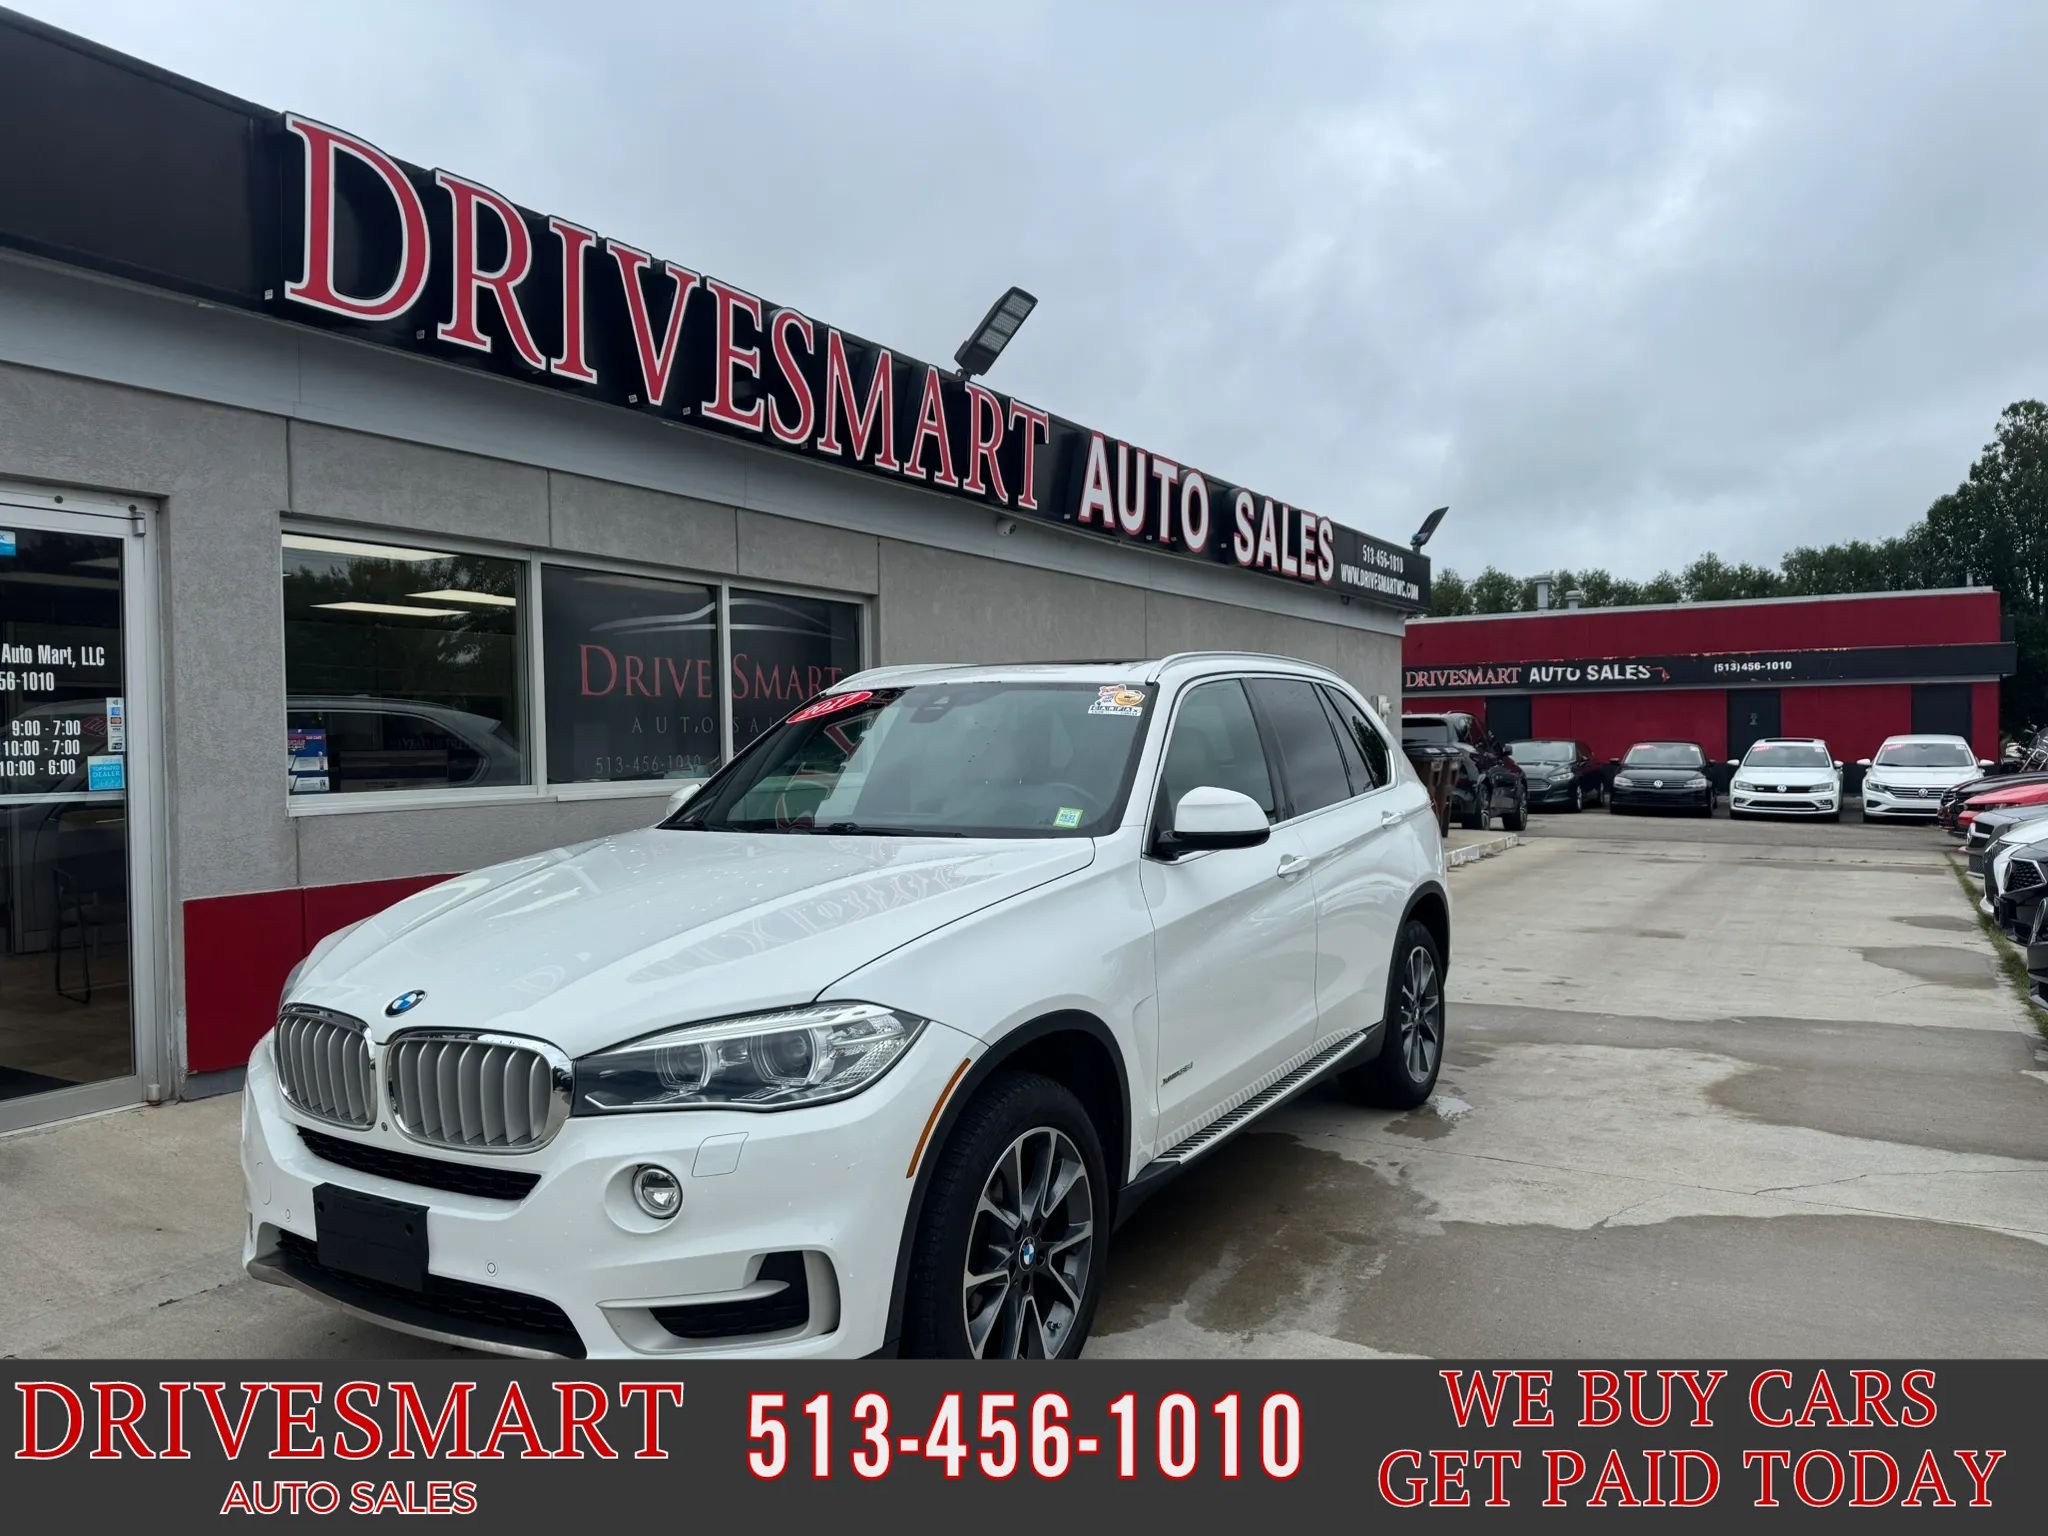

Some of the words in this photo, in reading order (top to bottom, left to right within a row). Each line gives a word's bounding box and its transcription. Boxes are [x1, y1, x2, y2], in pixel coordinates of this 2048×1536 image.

[285, 112, 1050, 511] DRIVESMART
[1078, 430, 1210, 553] AUTO
[1233, 487, 1335, 584] SALES
[1362, 544, 1404, 574] 513-456-1010
[1, 643, 33, 664] Auto
[38, 644, 76, 668] Mart,
[81, 645, 105, 666] LLC
[580, 644, 712, 698] DRIVE
[732, 653, 843, 700] SMART
[1405, 666, 1522, 688] DRIVESMART
[1529, 666, 1581, 683] AUTO
[1586, 663, 1651, 681] SALES
[1713, 661, 1792, 673] (513)456-1010
[12, 720, 40, 736] 9:00
[53, 720, 80, 735] 7:00
[632, 716, 714, 734] AUTO
[3, 740, 39, 756] 10:00
[52, 739, 80, 755] 7:00
[0, 760, 35, 776] 10:00
[48, 759, 76, 775] 6:00
